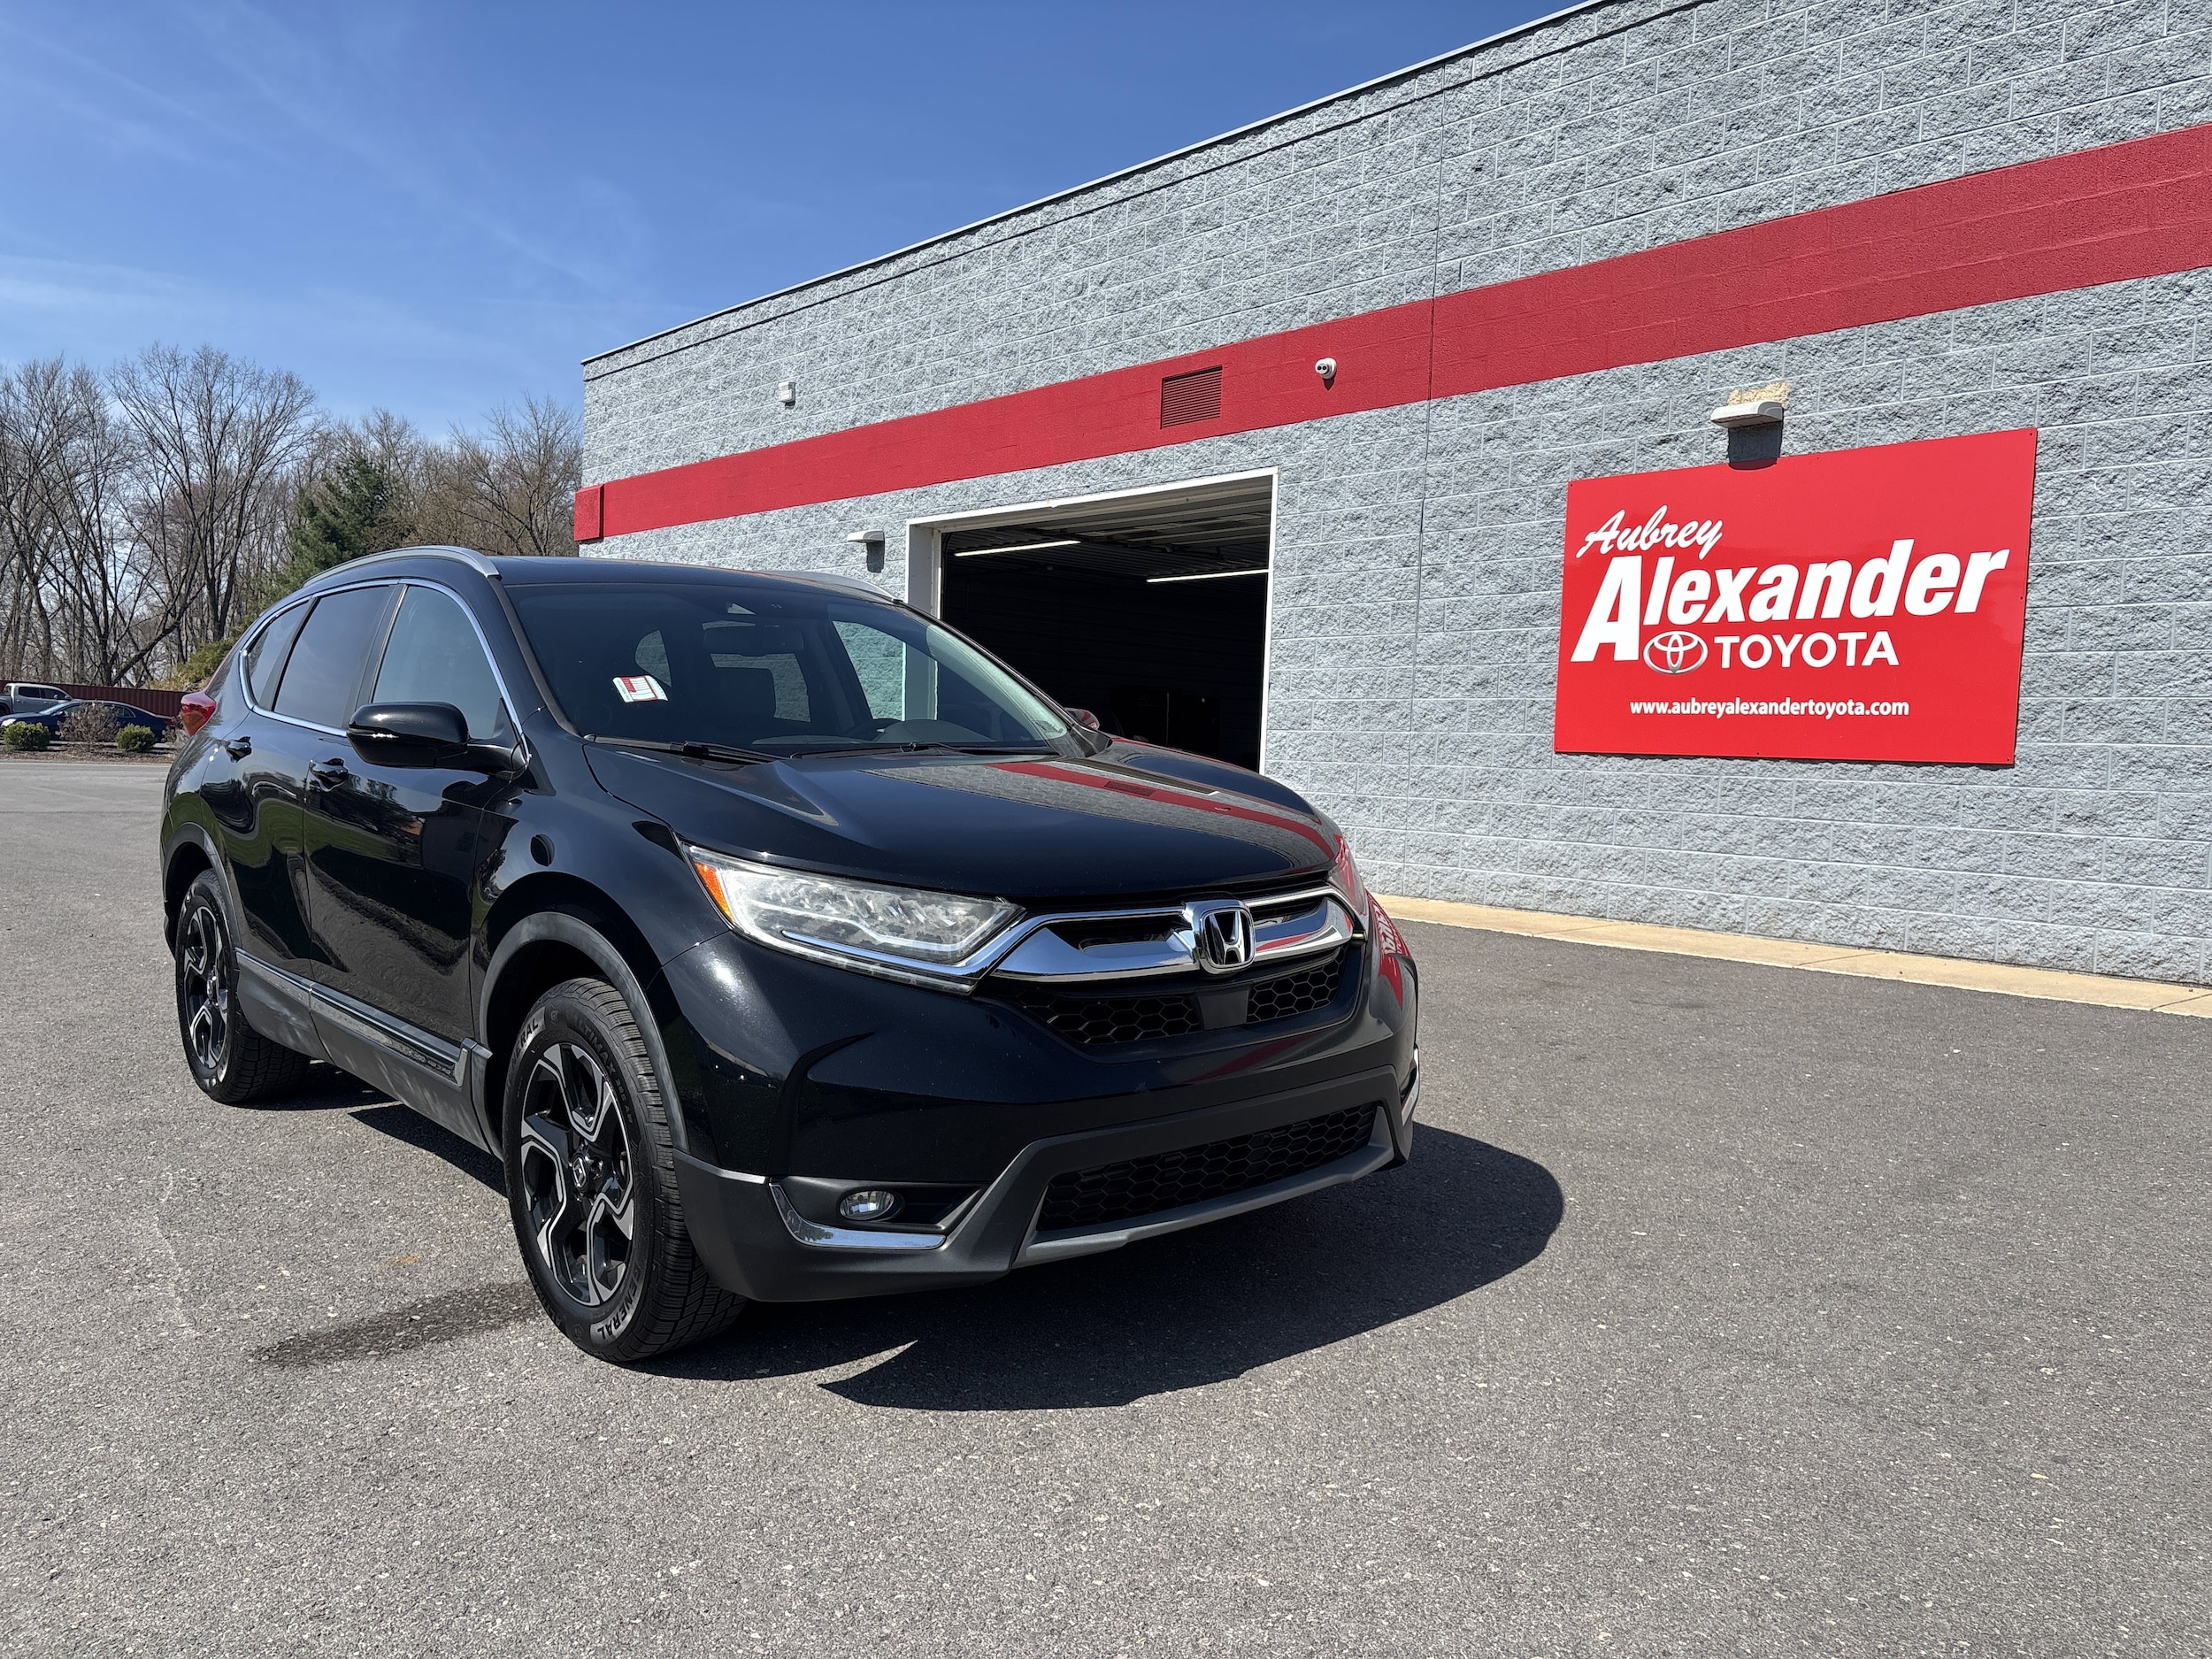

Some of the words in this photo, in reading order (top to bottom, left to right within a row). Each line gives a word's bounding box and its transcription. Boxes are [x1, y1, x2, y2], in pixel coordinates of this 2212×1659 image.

[1576, 504, 1723, 560] Aubrey
[1571, 538, 2010, 663] Alexander
[1714, 631, 1900, 669] TOYOTA
[1630, 696, 1909, 719] www.aubreyalexandertoyota.com
